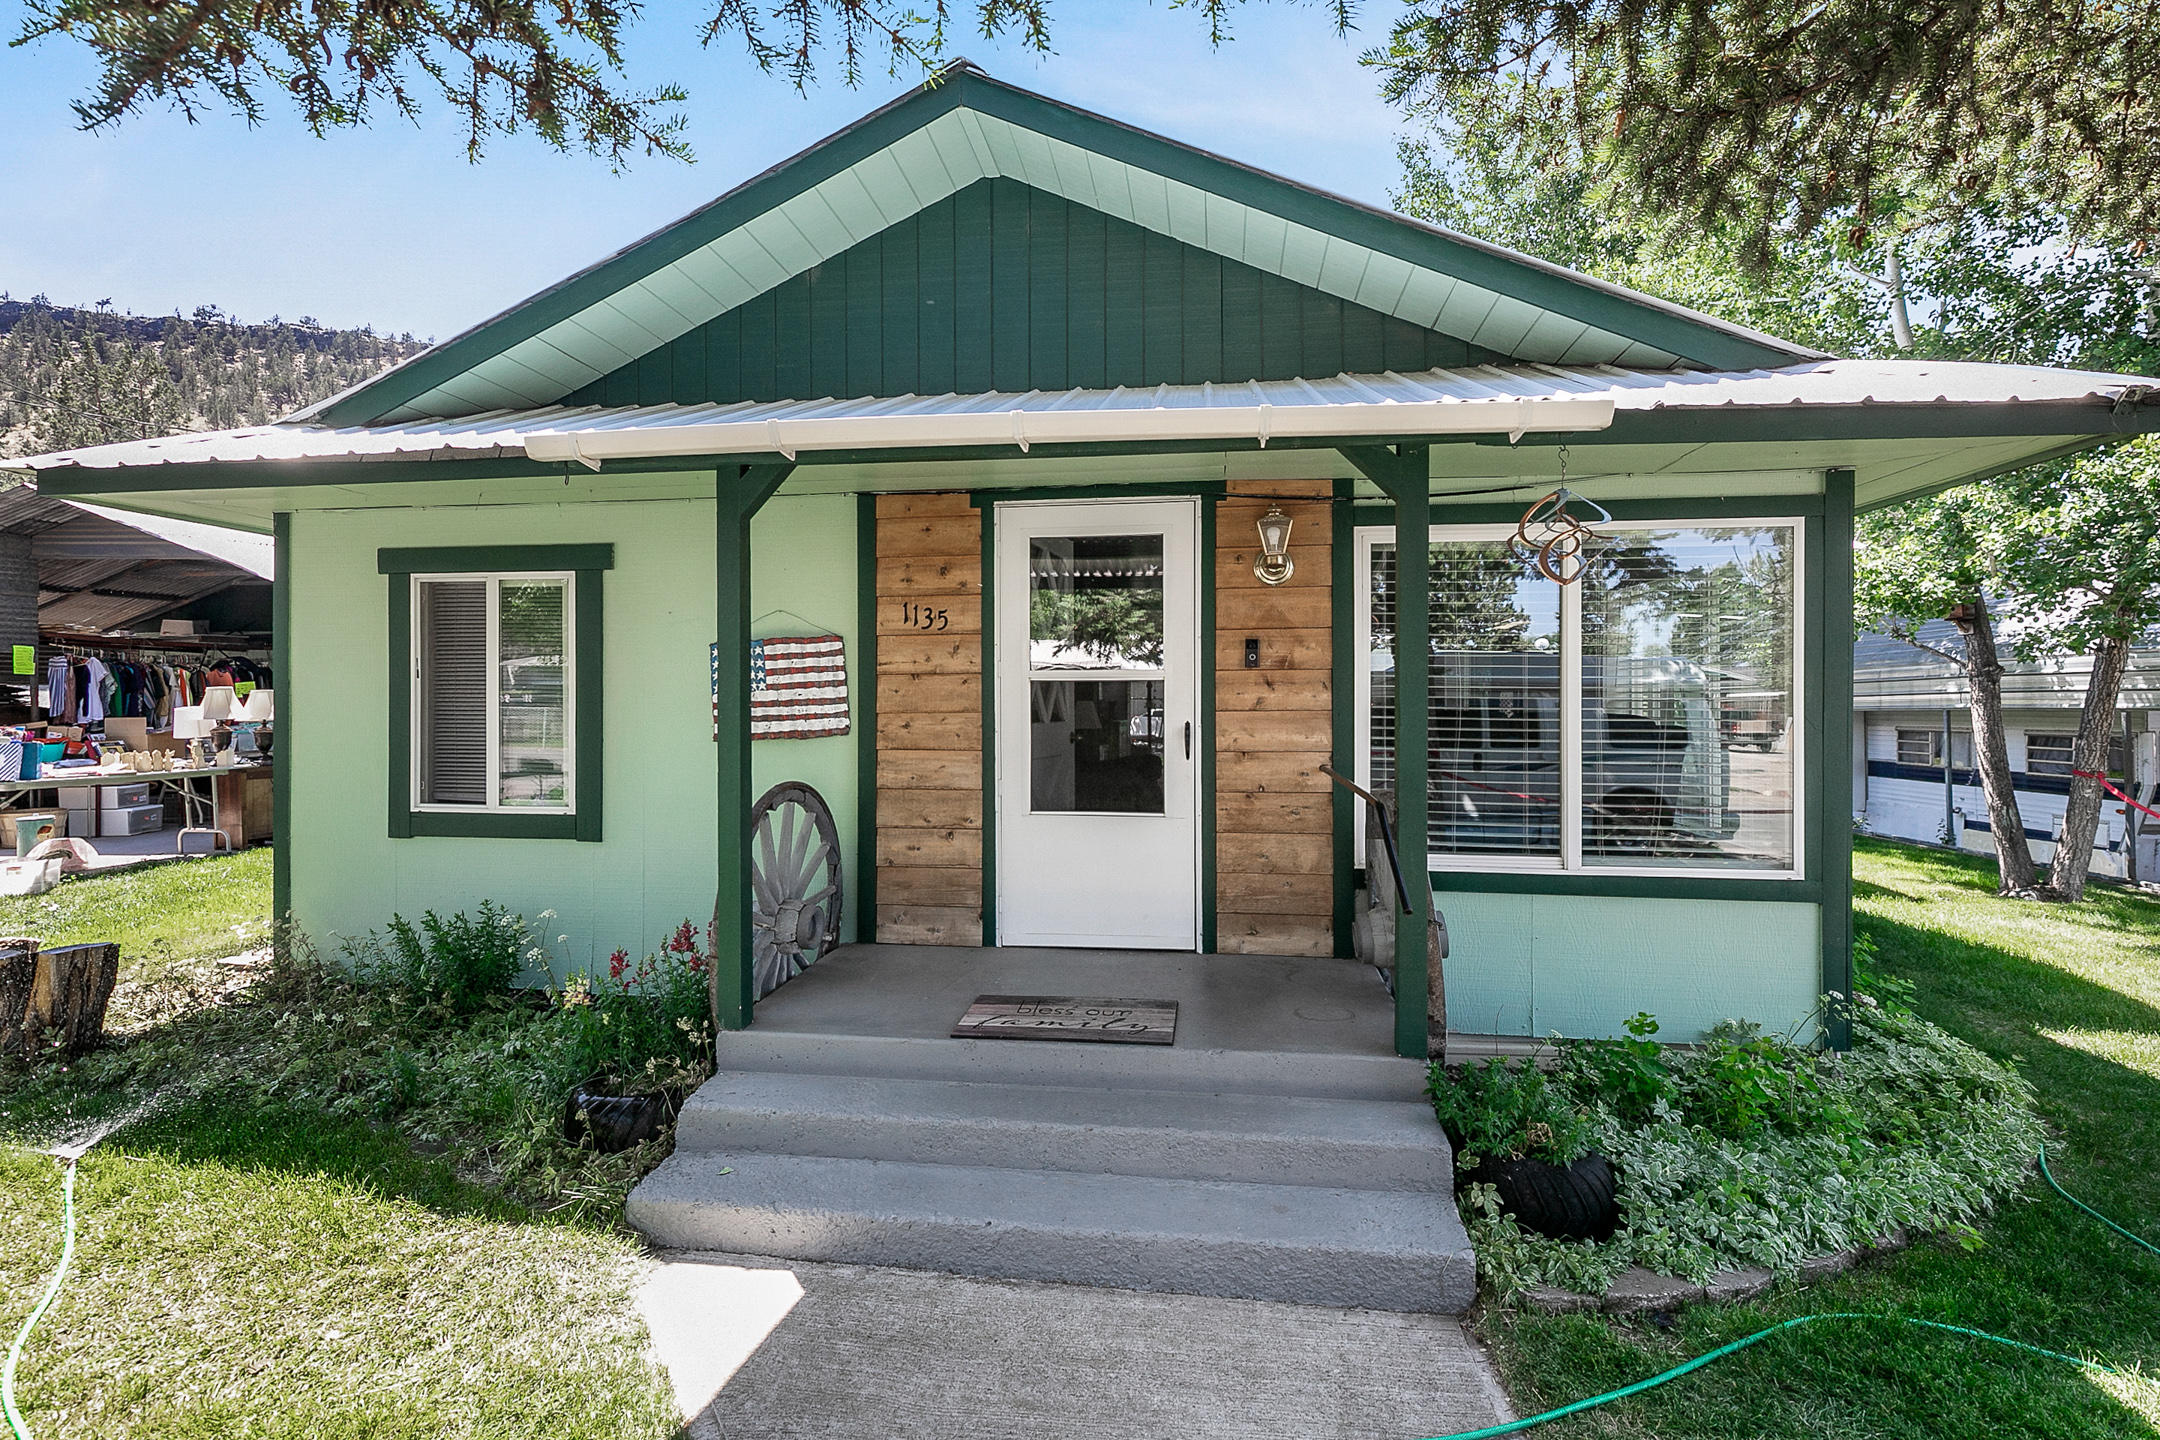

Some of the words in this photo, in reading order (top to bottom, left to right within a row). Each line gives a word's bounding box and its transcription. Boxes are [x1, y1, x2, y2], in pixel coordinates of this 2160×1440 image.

[902, 601, 949, 631] 1135
[1016, 1000, 1078, 1017] bless
[1085, 1008, 1133, 1017] our
[972, 1014, 1160, 1035] family
